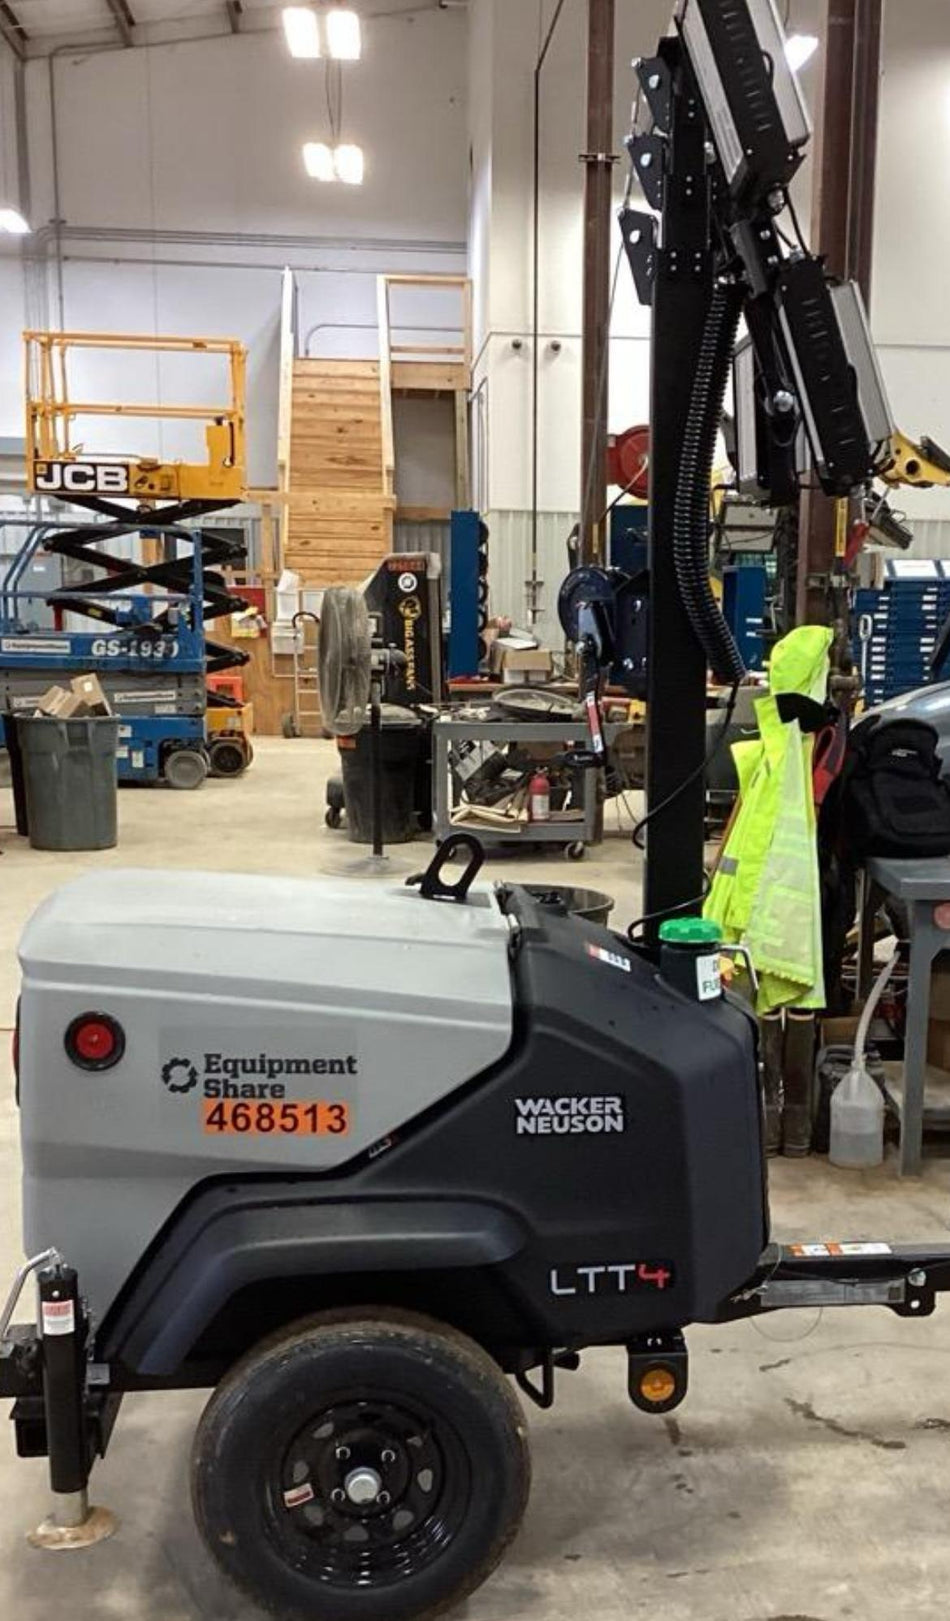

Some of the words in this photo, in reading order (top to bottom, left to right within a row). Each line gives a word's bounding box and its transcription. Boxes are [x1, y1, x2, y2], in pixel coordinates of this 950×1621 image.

[36, 463, 128, 492] JCB
[204, 1053, 358, 1079] Equipment
[203, 1078, 286, 1099] Share
[206, 1102, 347, 1134] 468513
[515, 1096, 623, 1115] WACKER
[516, 1115, 624, 1134] NEUSON
[550, 1263, 671, 1296] LTT4
